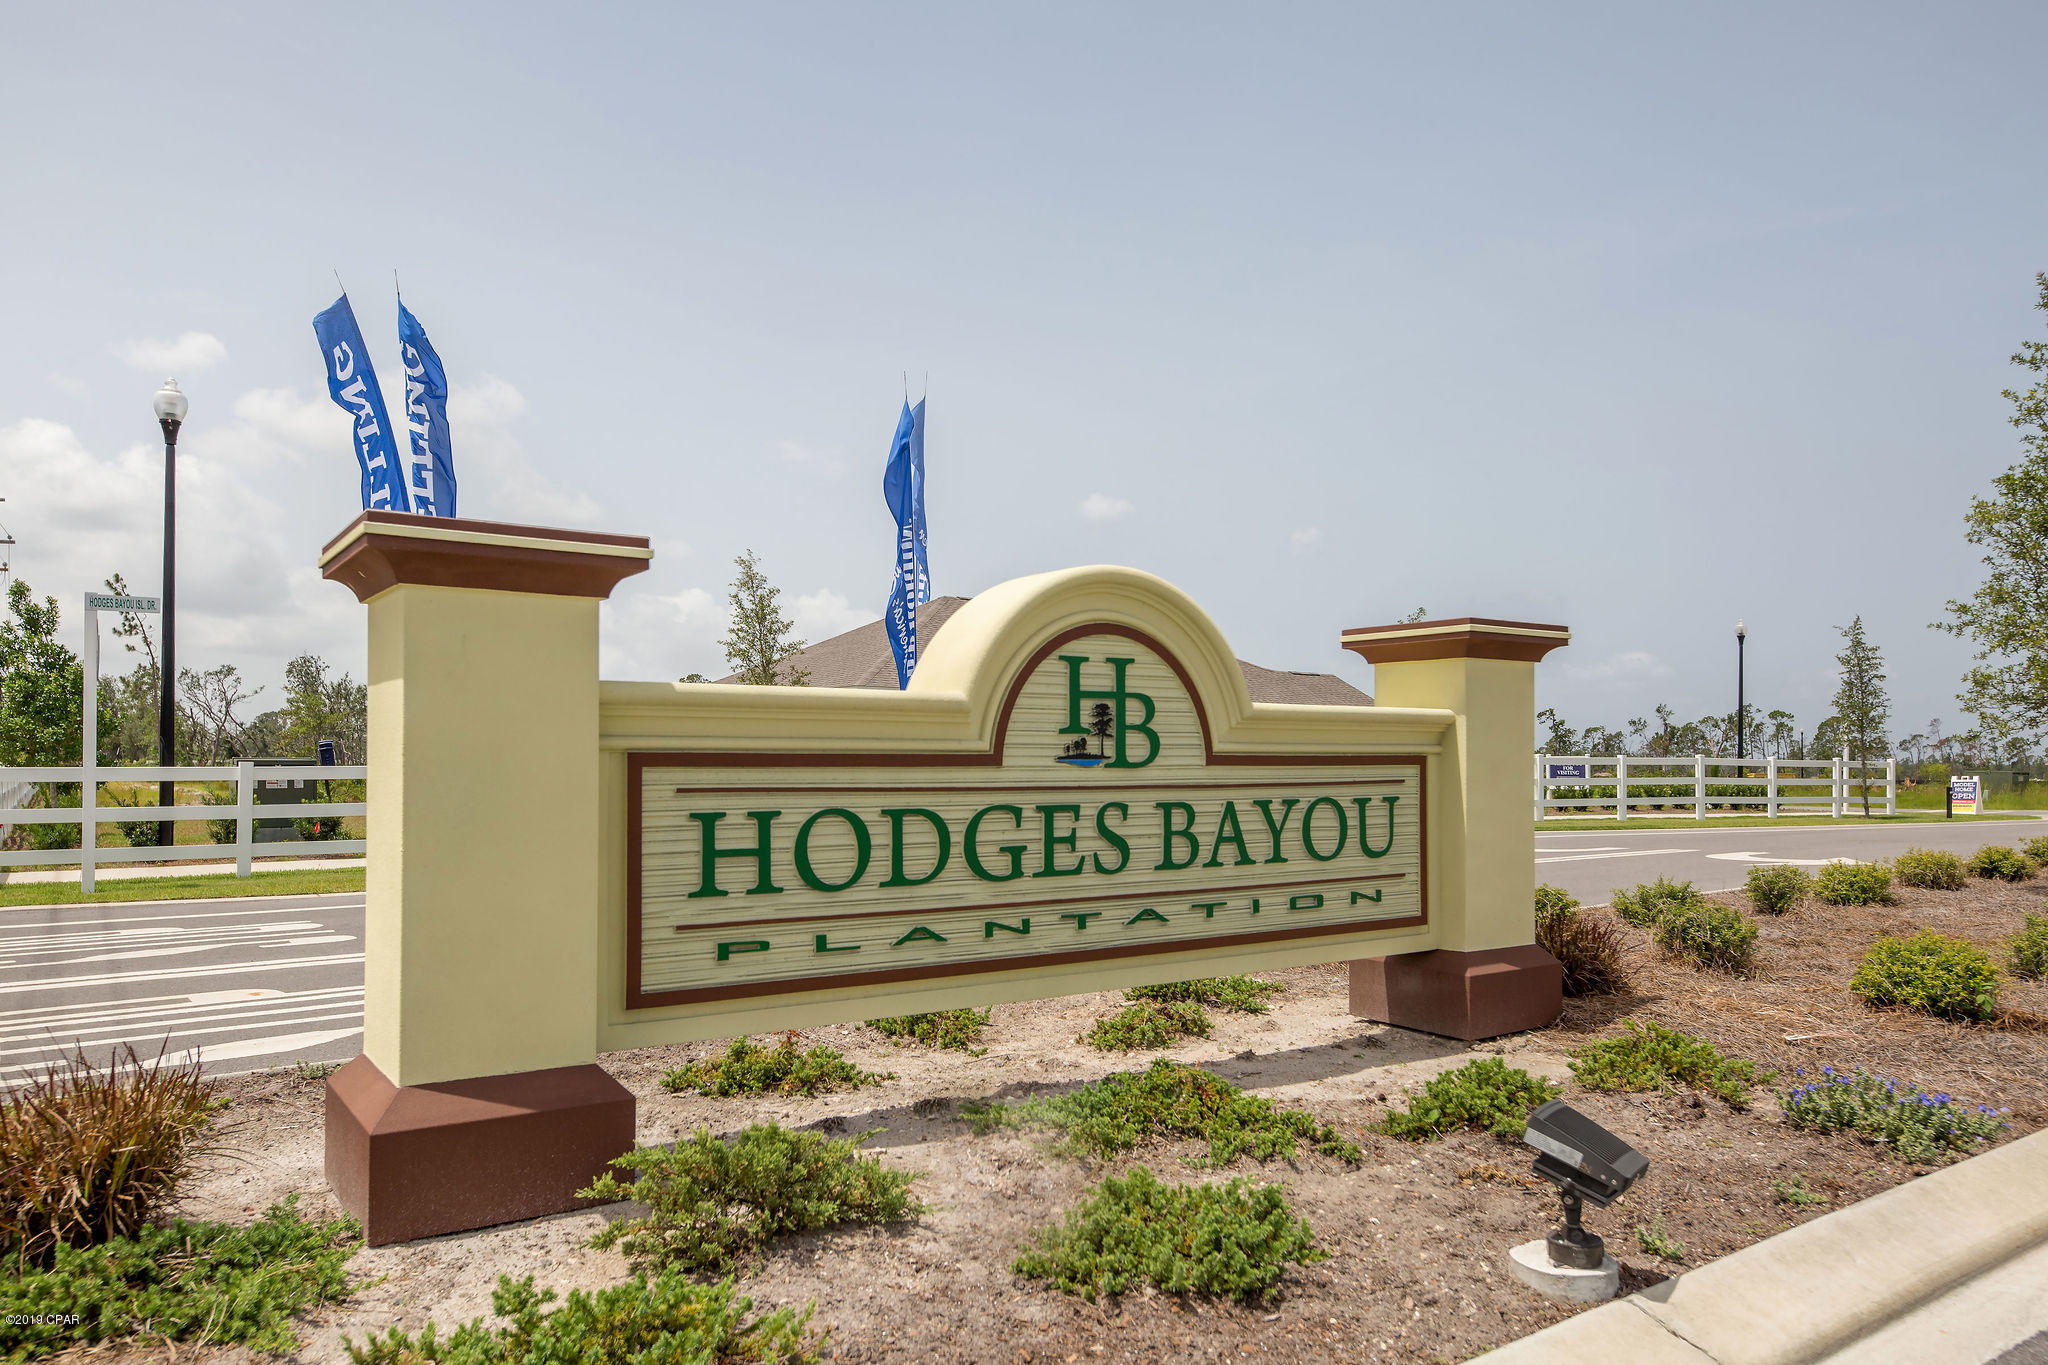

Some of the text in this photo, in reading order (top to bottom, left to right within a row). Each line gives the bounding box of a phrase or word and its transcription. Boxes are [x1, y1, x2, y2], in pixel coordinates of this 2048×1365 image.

[89, 597, 114, 608] HODGES
[115, 598, 134, 609] BAYOU
[148, 601, 157, 610] DR.
[1058, 655, 1161, 769] HB
[688, 795, 1400, 899] HODGES BAYOU
[715, 889, 1383, 963] PLANTATION
